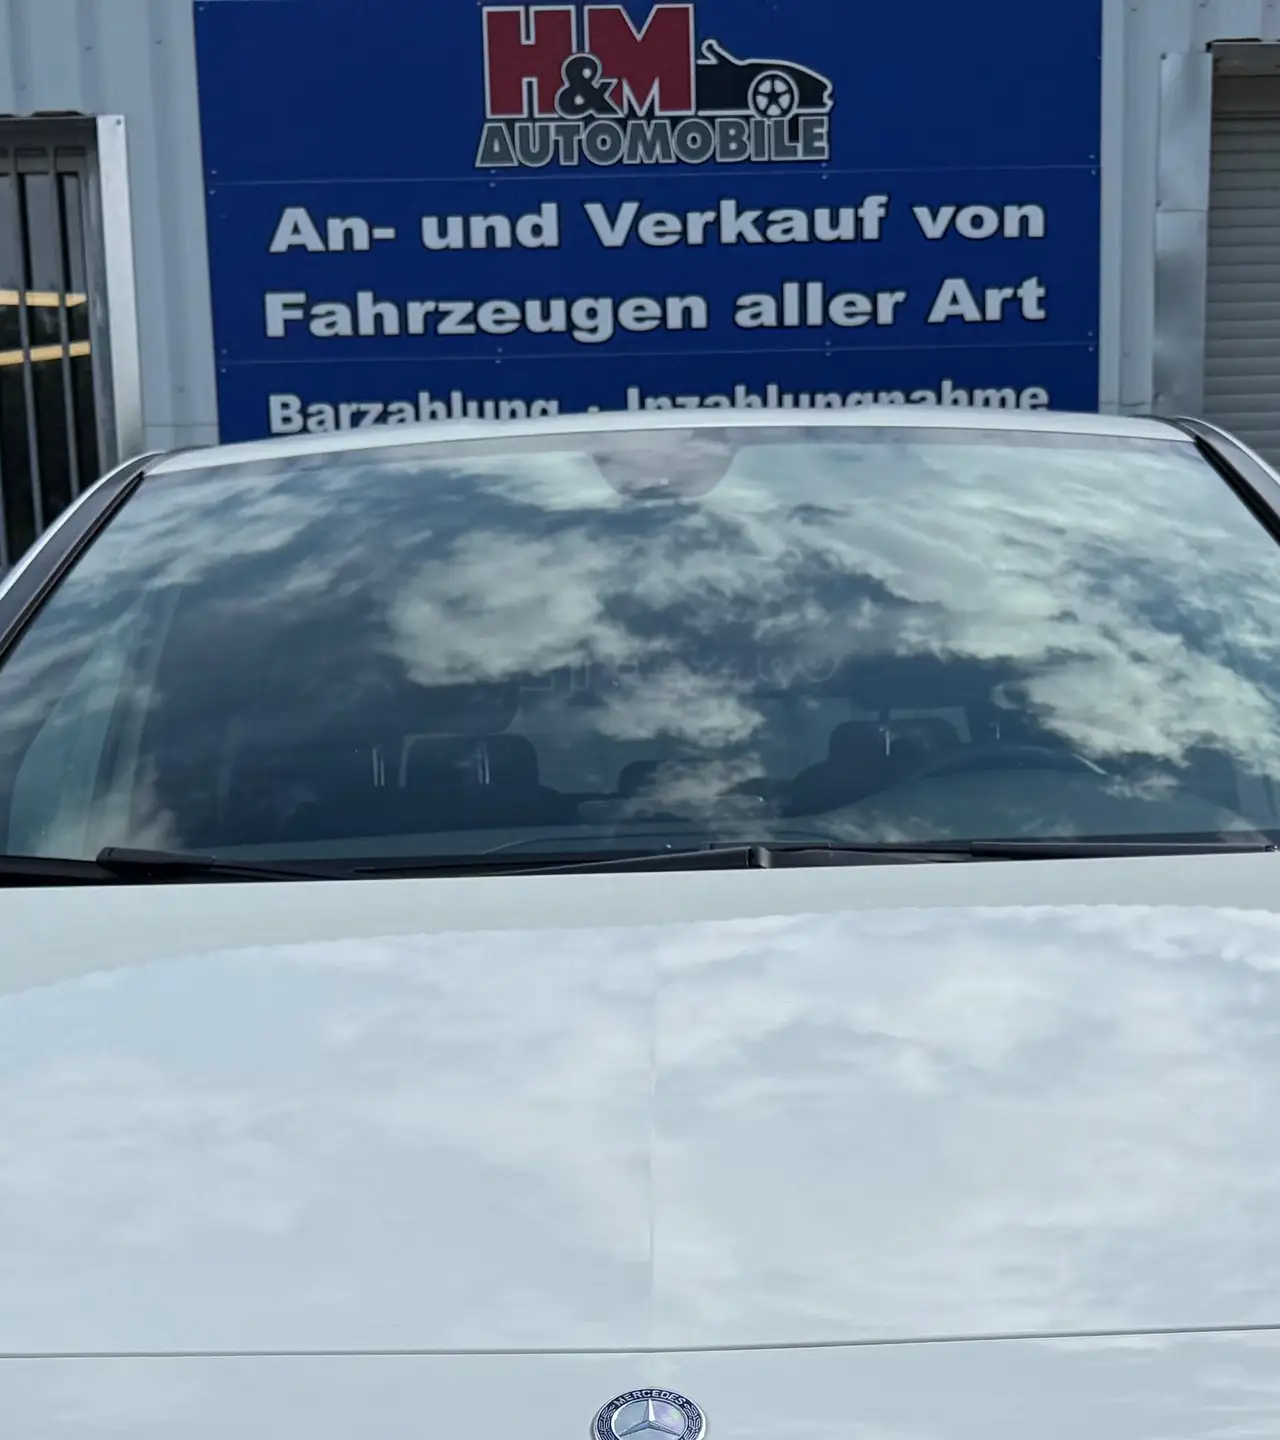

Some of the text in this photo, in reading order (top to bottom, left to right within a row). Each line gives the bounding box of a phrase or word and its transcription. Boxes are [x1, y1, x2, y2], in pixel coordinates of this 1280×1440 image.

[482, 3, 695, 119] H&M
[475, 116, 830, 168] AUTOMOBILE
[269, 195, 1045, 252] An- und Verkauf von
[265, 276, 1046, 343] Fahrzeugen aller Art
[612, 1389, 686, 1406] MERCEDES
